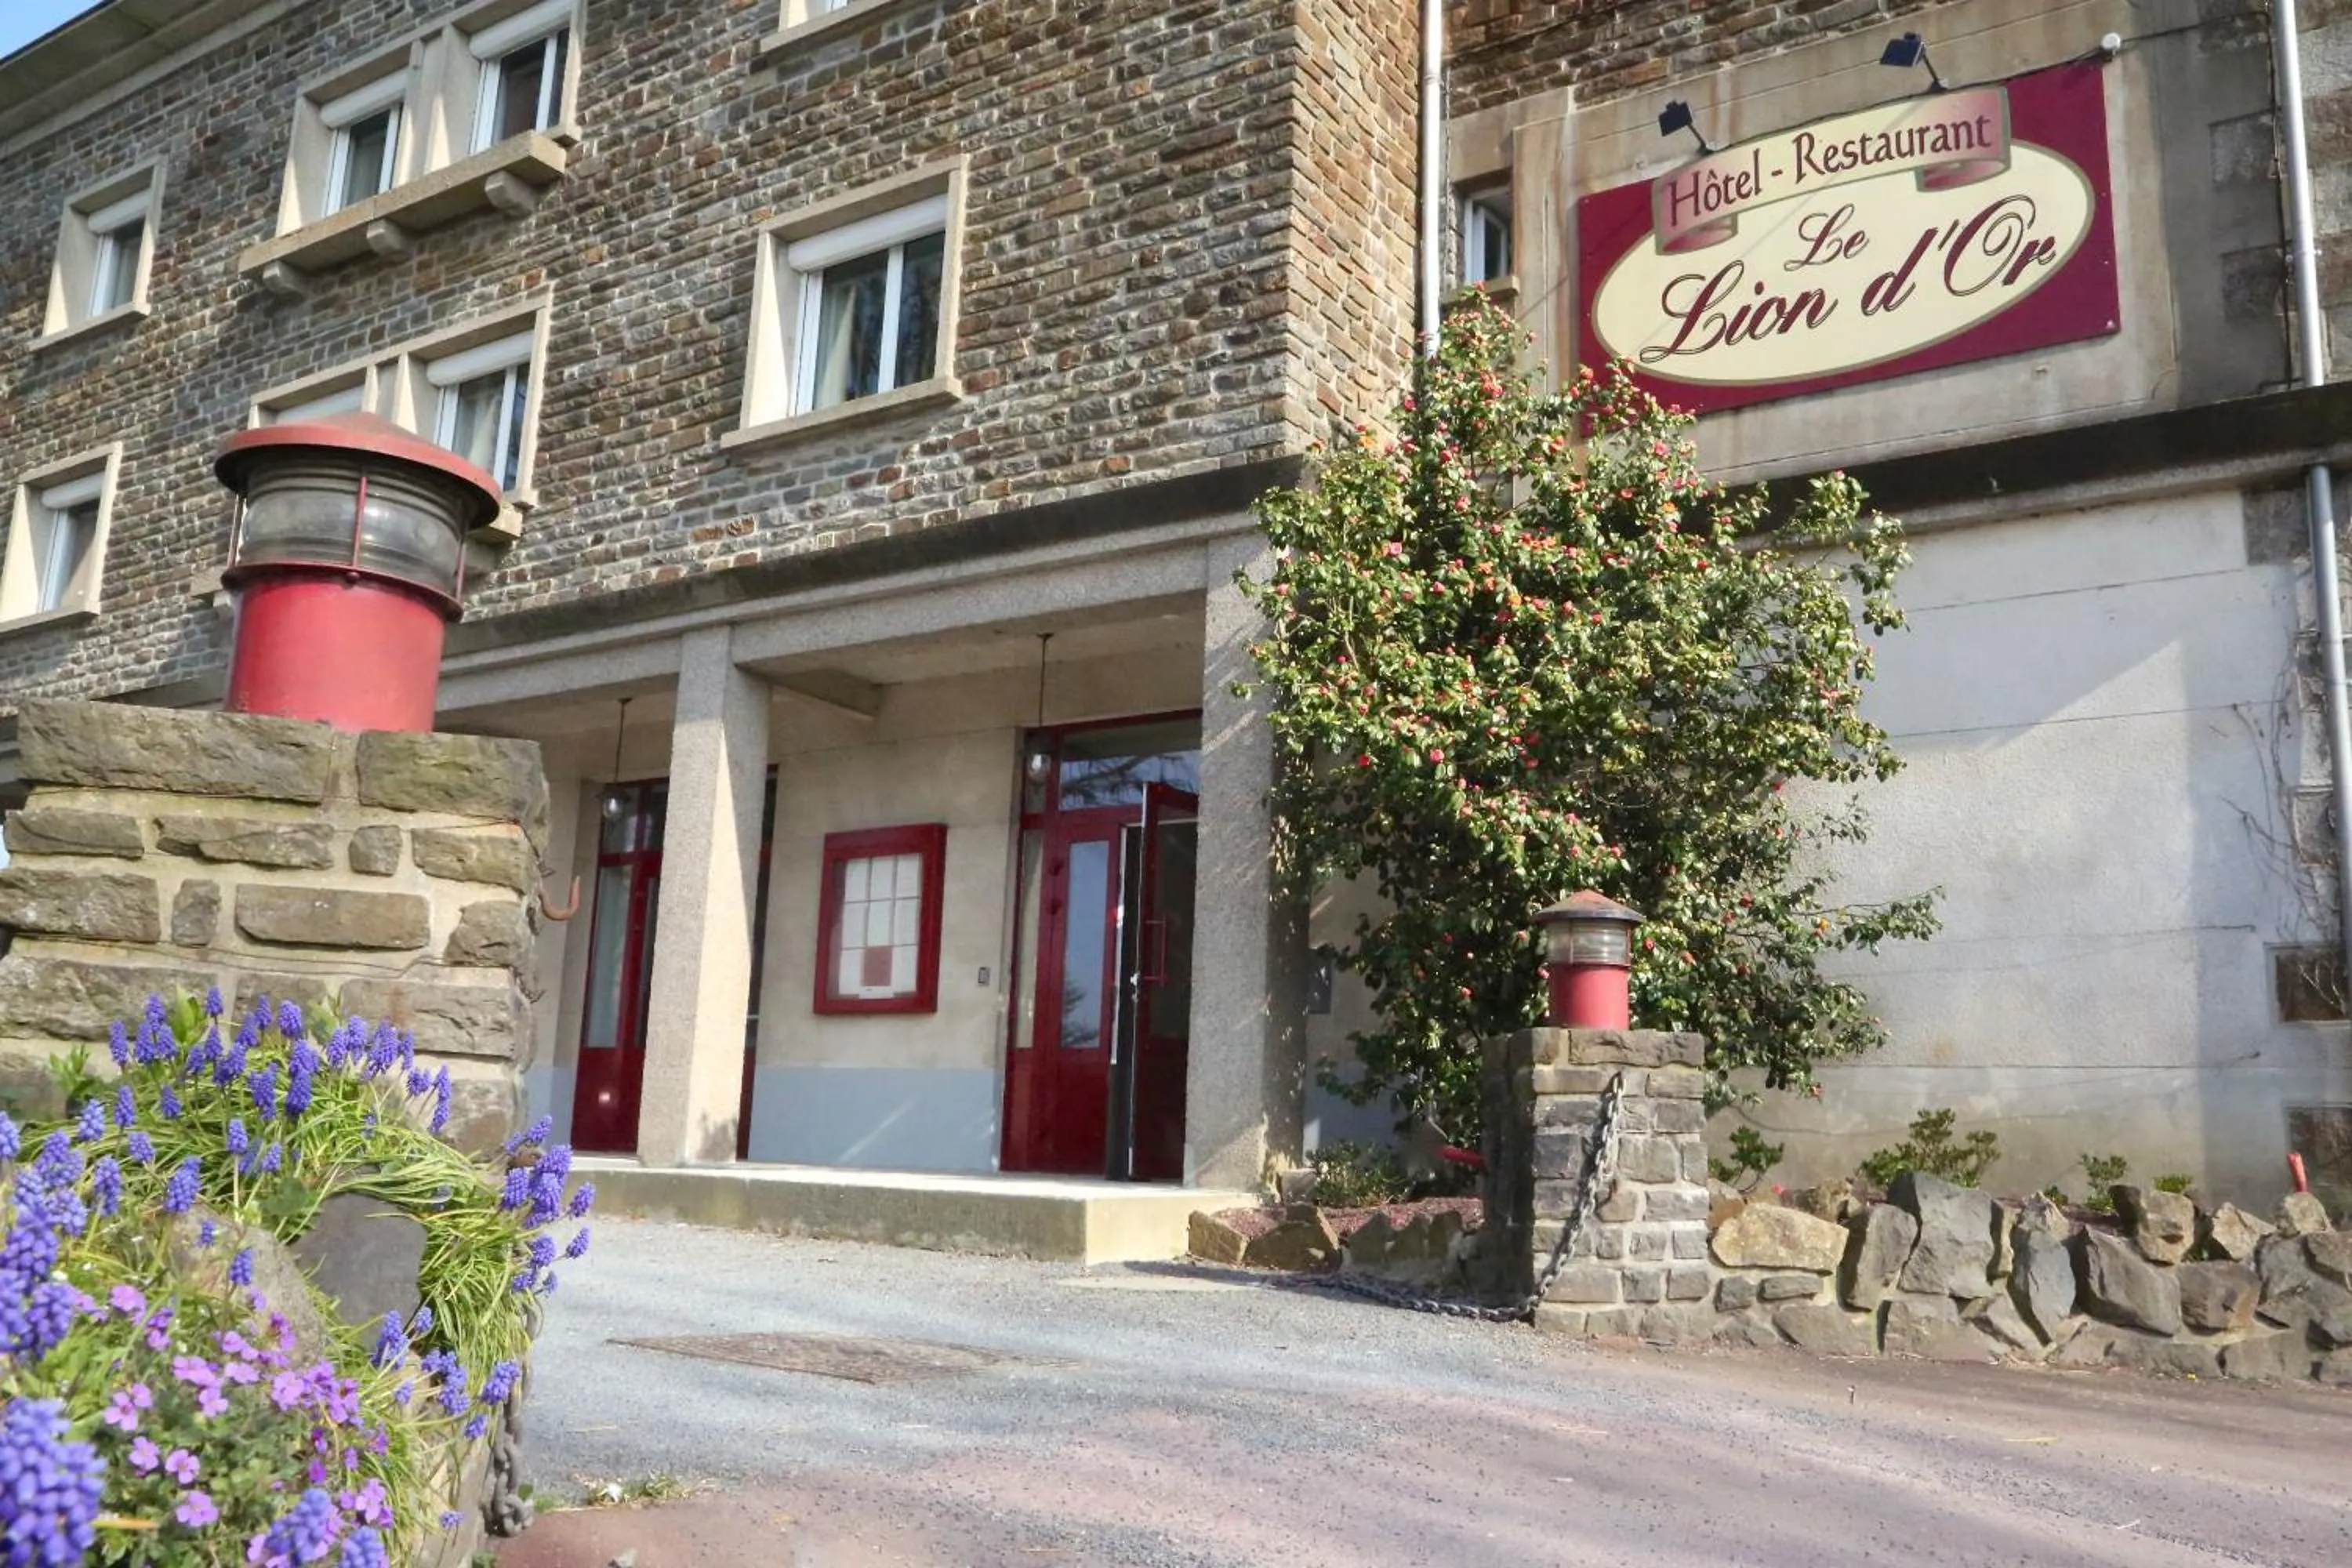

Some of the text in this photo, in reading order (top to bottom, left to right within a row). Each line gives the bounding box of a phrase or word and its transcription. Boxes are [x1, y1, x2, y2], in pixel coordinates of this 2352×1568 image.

[1791, 114, 1992, 184] Restaurant
[1784, 203, 1870, 272] Le
[1639, 194, 2056, 364] Lion d'Or
